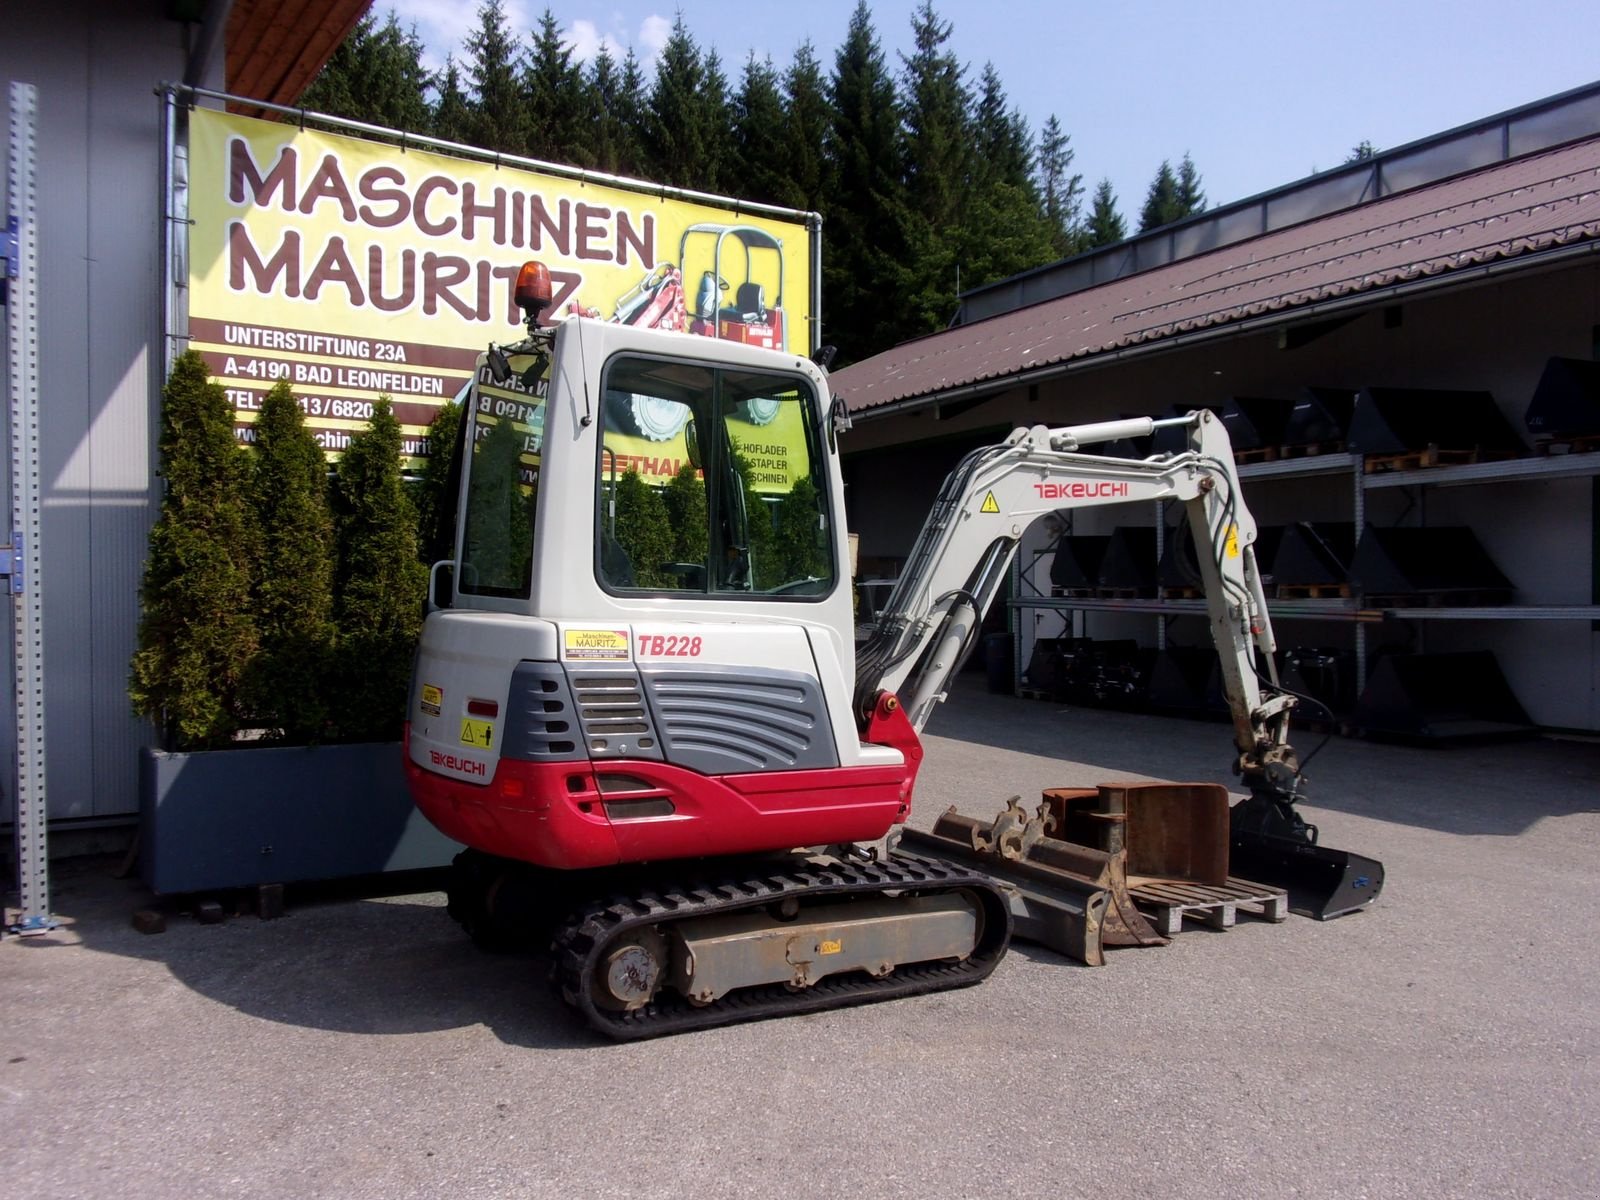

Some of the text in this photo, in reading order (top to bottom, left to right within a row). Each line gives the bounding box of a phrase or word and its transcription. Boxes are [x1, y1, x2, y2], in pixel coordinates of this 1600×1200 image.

[228, 137, 654, 270] MASCHINEN
[228, 221, 583, 327] MAURITZ
[224, 324, 407, 363] UNTERSTIFTUNG 23A
[224, 356, 444, 396] A-4190 BAD LEONFELDEN
[638, 635, 702, 657] TB228
